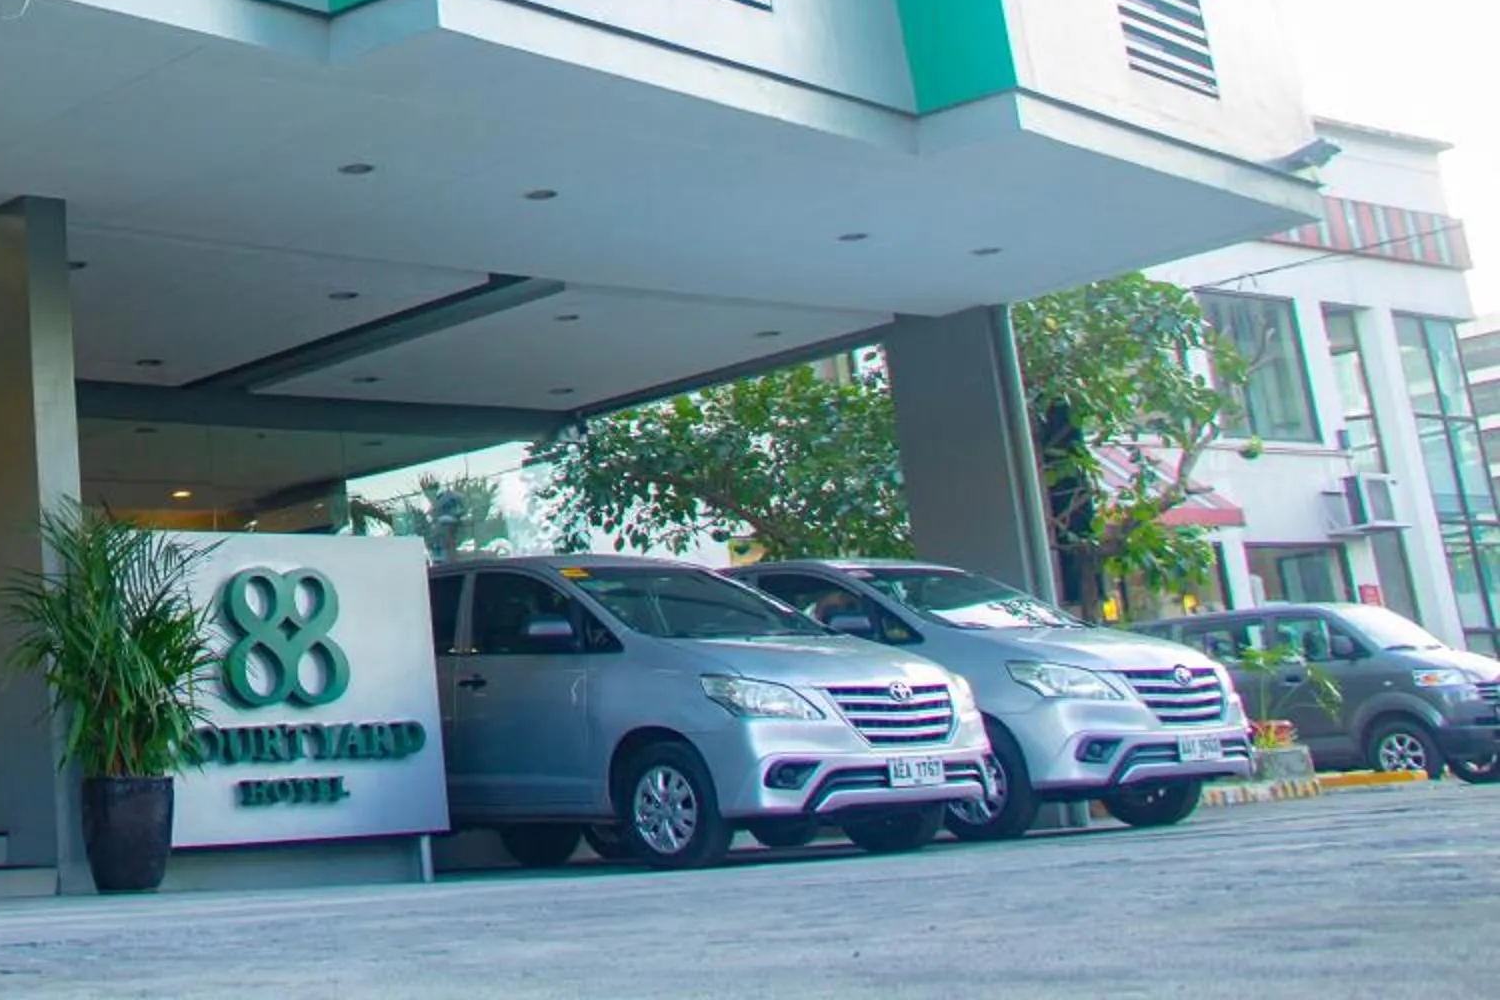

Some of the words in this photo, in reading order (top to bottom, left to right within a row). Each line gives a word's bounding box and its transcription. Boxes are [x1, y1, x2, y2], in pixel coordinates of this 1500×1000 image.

[223, 566, 351, 707] 88
[186, 719, 427, 766] OURTYARD
[236, 775, 350, 806] HOTEL
